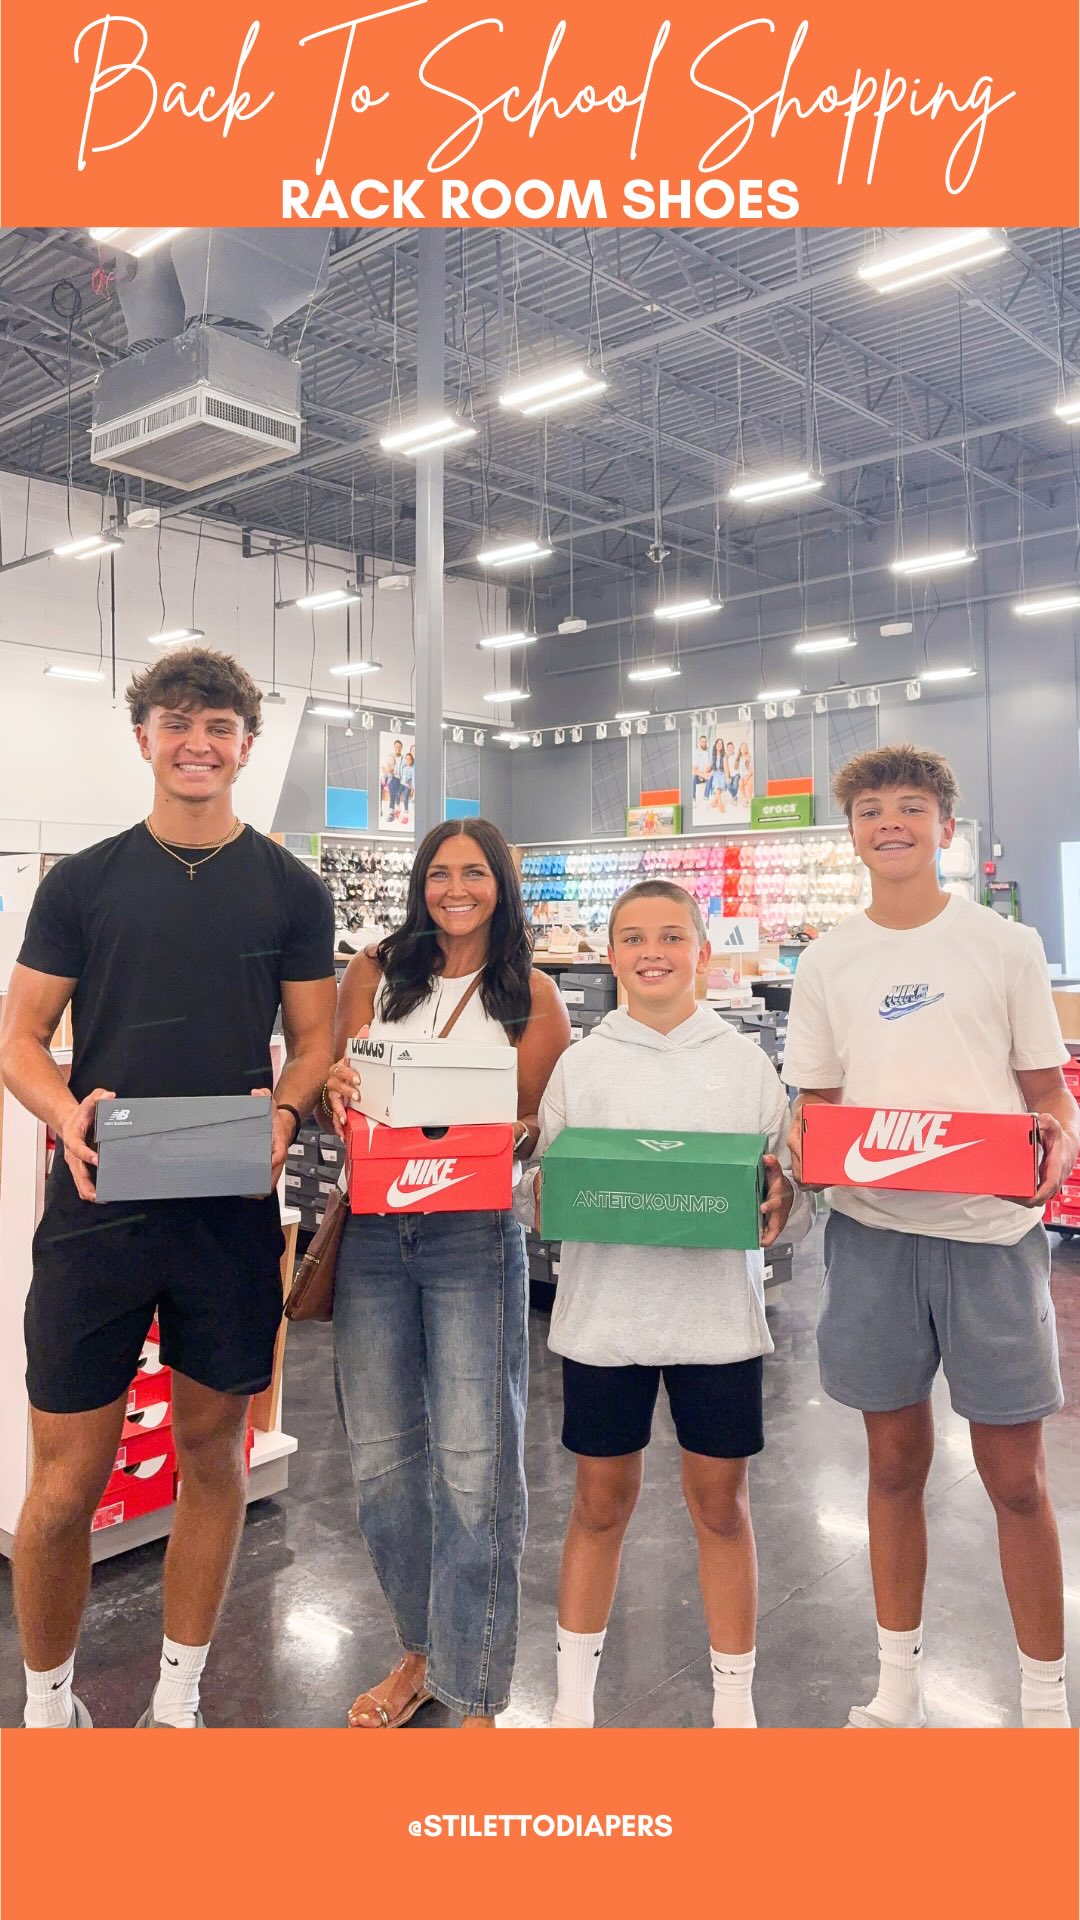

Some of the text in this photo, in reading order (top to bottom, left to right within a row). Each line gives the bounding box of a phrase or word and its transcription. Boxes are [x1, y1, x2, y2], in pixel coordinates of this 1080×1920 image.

[762, 803, 796, 815] crocs
[888, 984, 929, 999] NIKE
[862, 1110, 953, 1152] NIKE
[399, 1158, 458, 1185] NIKE
[572, 1190, 729, 1214] ANTETOKOUNMPO
